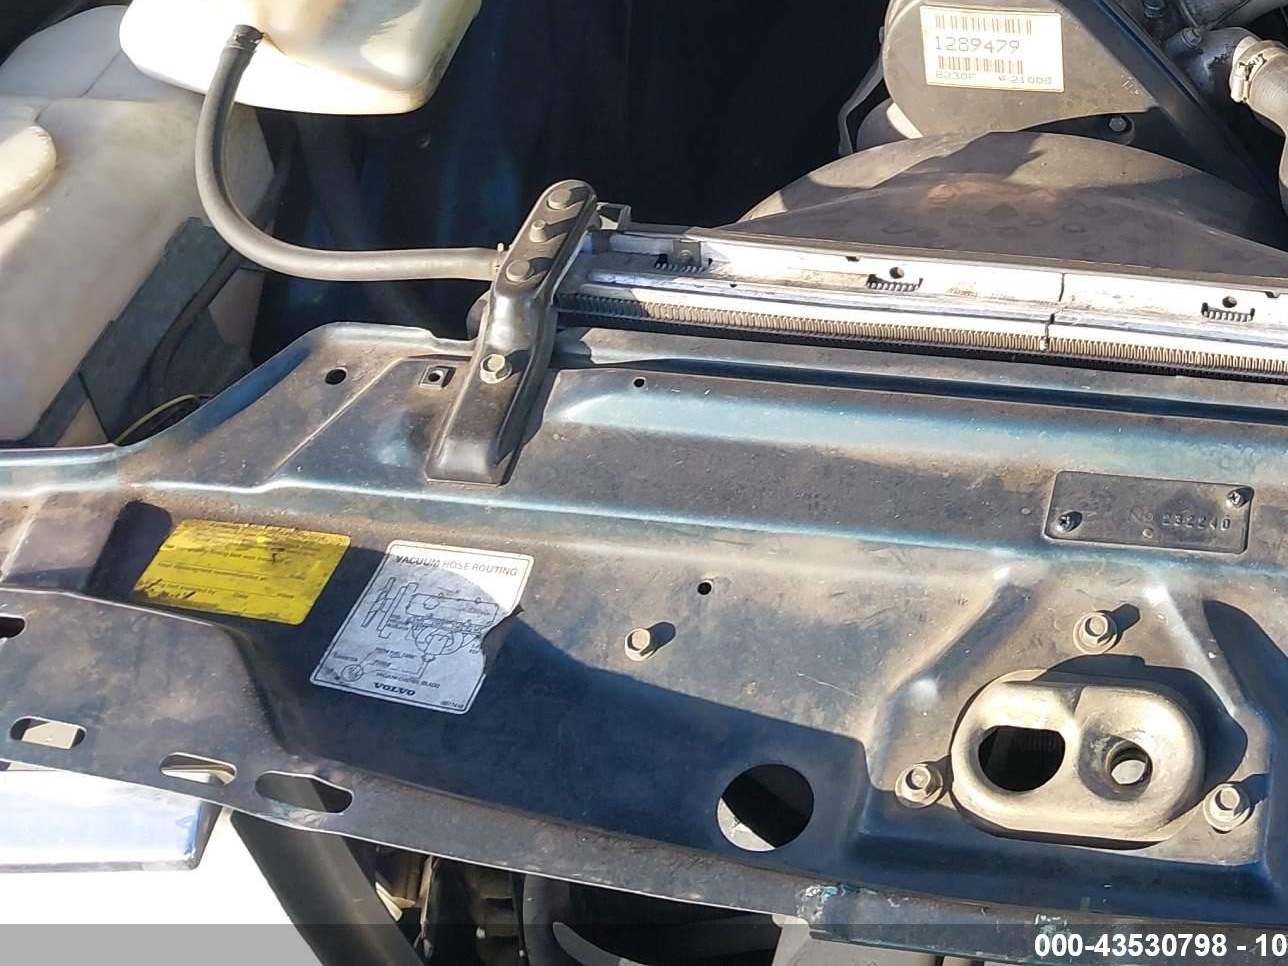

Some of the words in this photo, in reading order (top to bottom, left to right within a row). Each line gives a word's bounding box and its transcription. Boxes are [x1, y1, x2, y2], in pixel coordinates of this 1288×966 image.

[935, 36, 1020, 54] 1289479
[395, 555, 441, 568] VACUUM
[442, 560, 471, 571] HOSE
[472, 564, 519, 577] ROUTING
[373, 681, 416, 696] VOLVO
